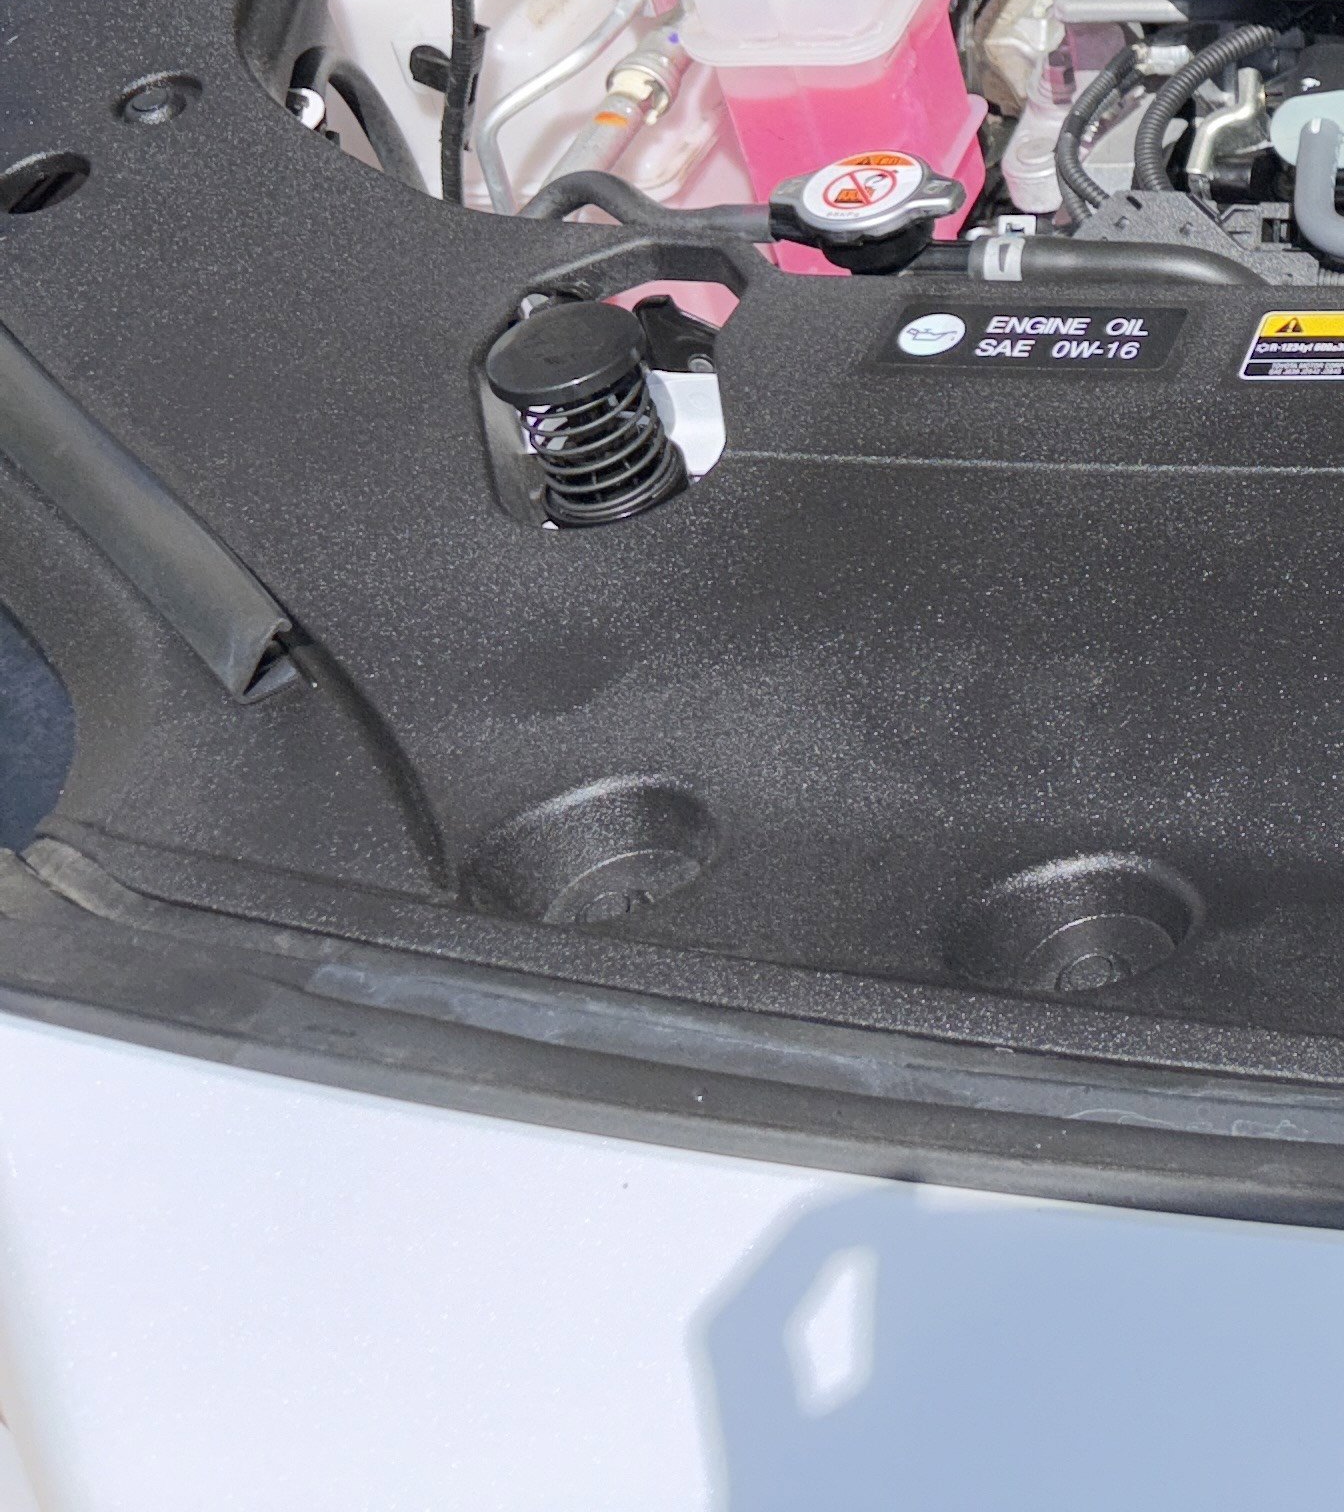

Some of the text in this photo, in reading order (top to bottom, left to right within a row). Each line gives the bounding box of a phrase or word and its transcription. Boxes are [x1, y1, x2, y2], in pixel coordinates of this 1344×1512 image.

[985, 315, 1149, 336] ENGINE OIL
[974, 338, 1141, 360] SAE 0W-16
